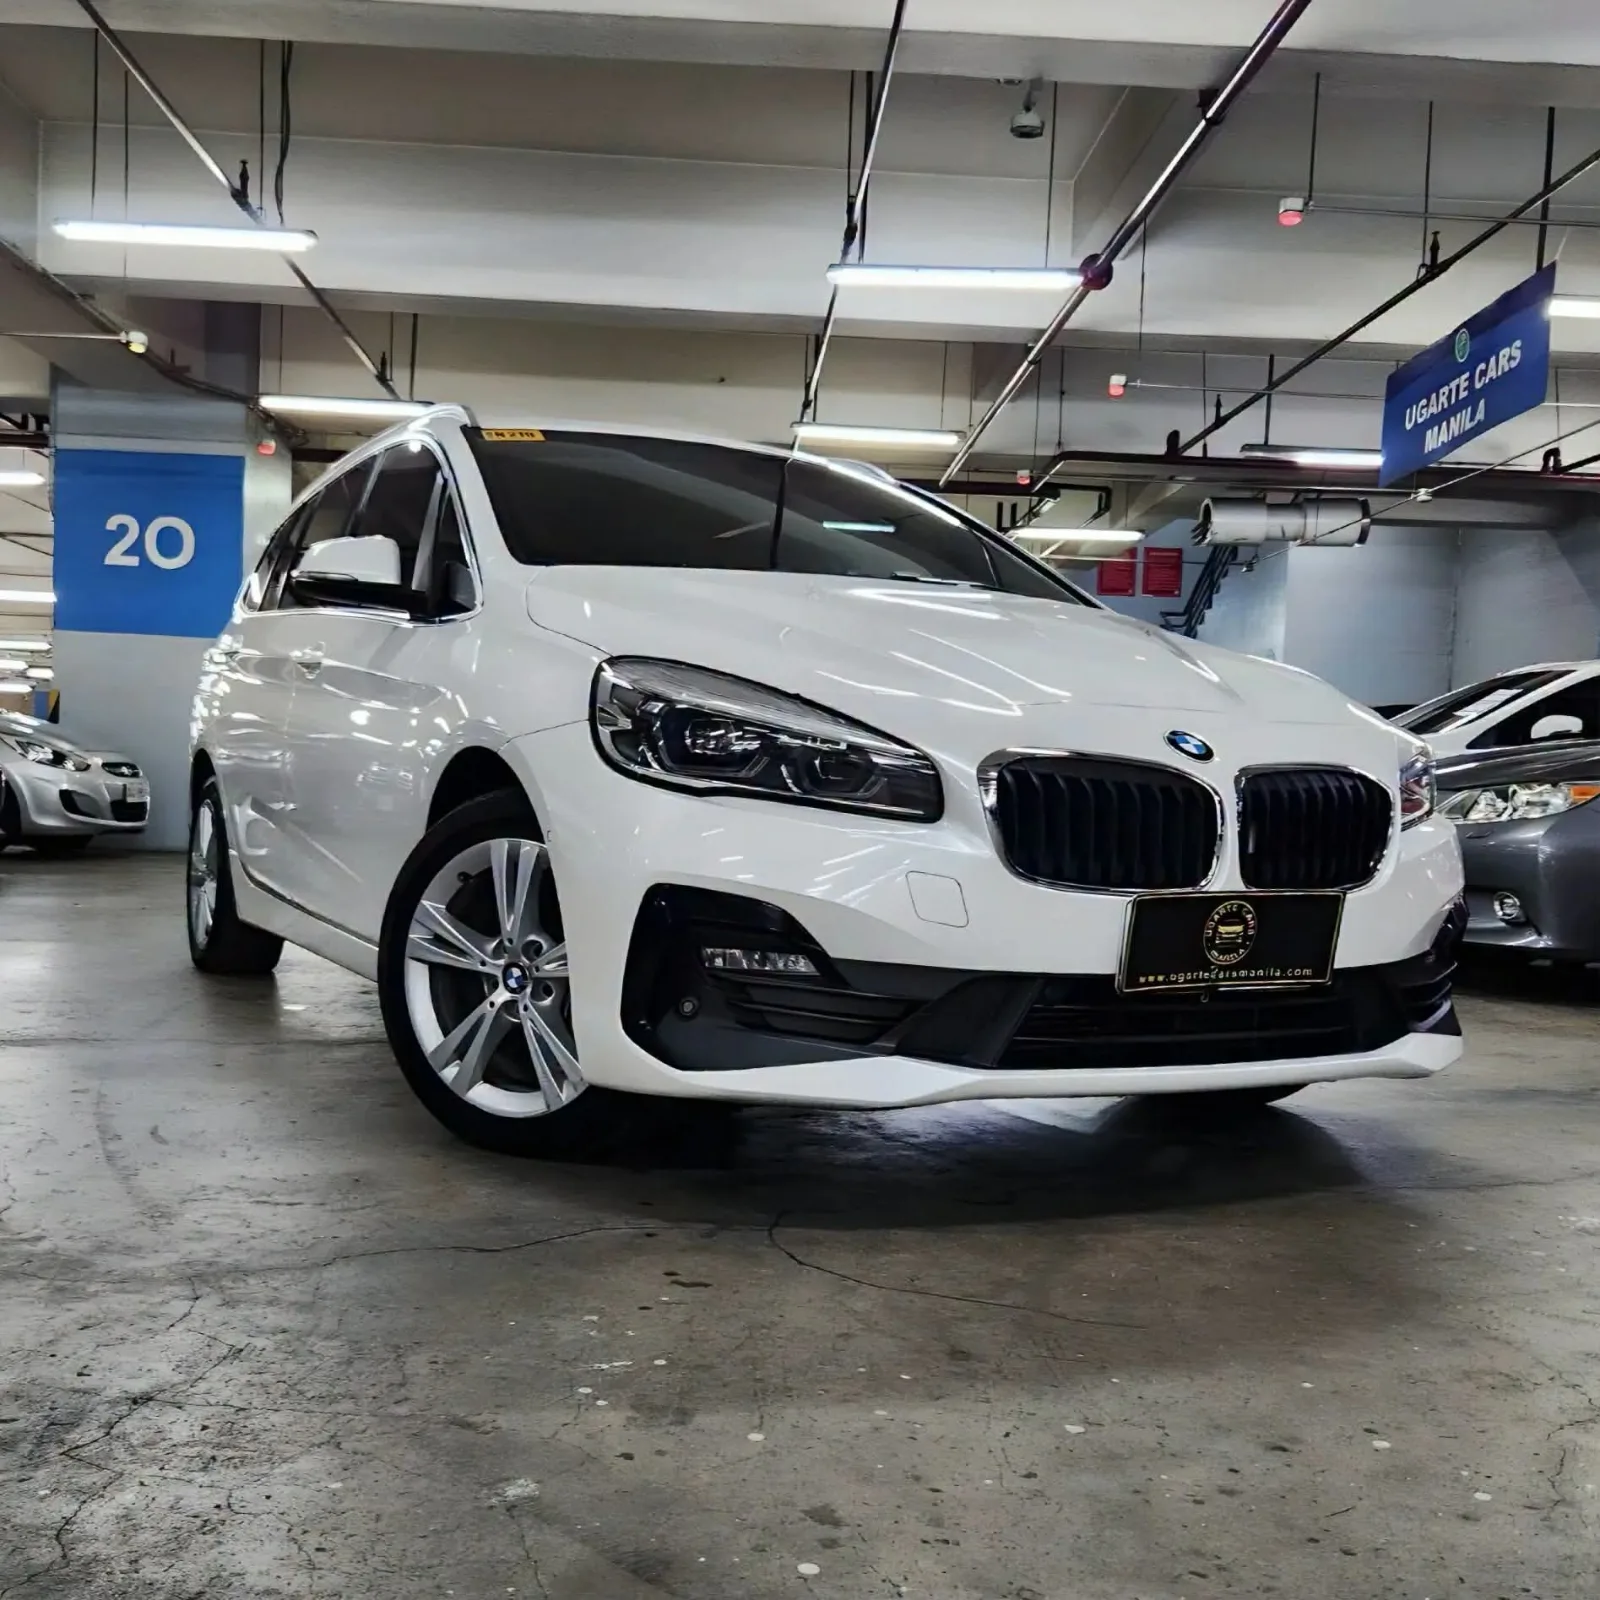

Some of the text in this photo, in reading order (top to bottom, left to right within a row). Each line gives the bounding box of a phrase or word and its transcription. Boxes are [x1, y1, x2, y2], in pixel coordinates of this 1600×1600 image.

[1405, 339, 1522, 431] UGARTE CARS
[1424, 398, 1486, 454] MANILA
[104, 513, 195, 570] 20
